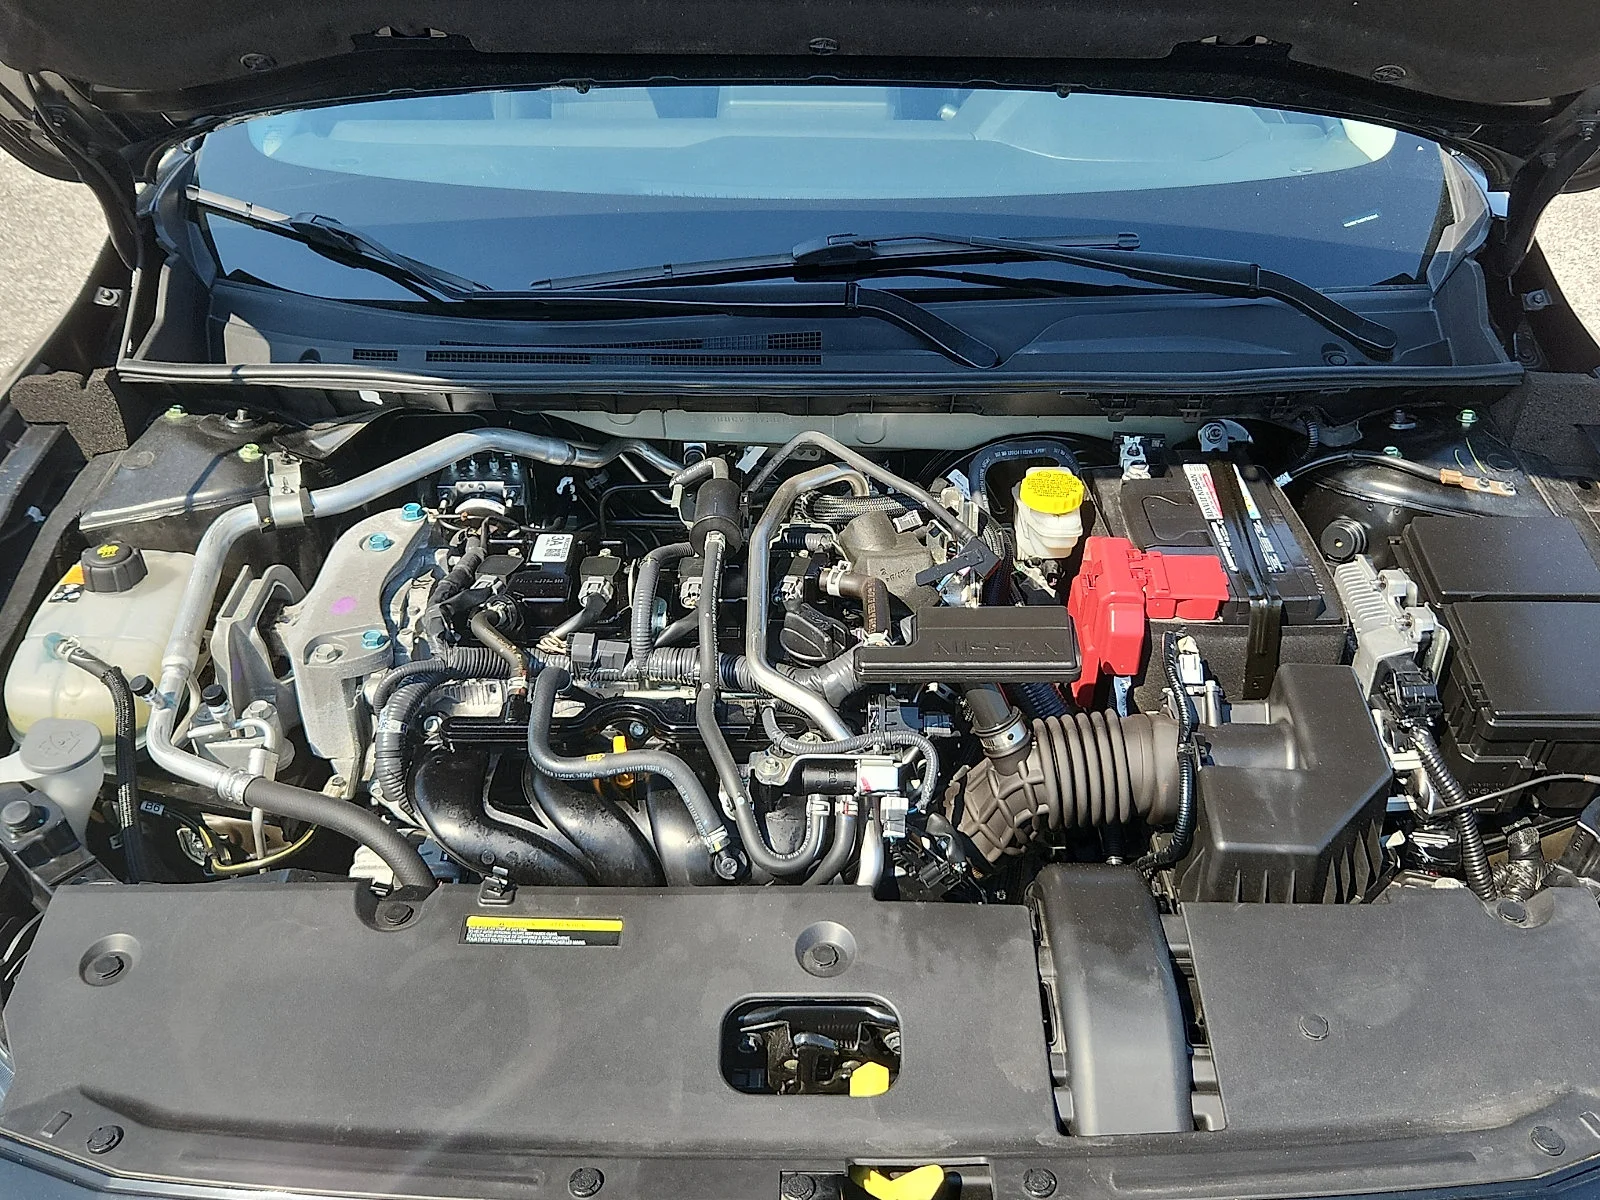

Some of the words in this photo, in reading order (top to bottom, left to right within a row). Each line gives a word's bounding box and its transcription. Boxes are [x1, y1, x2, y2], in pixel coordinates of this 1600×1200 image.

[1190, 474, 1205, 496] NISSAN
[933, 640, 1064, 656] NISSAN
[145, 801, 161, 812] B6
